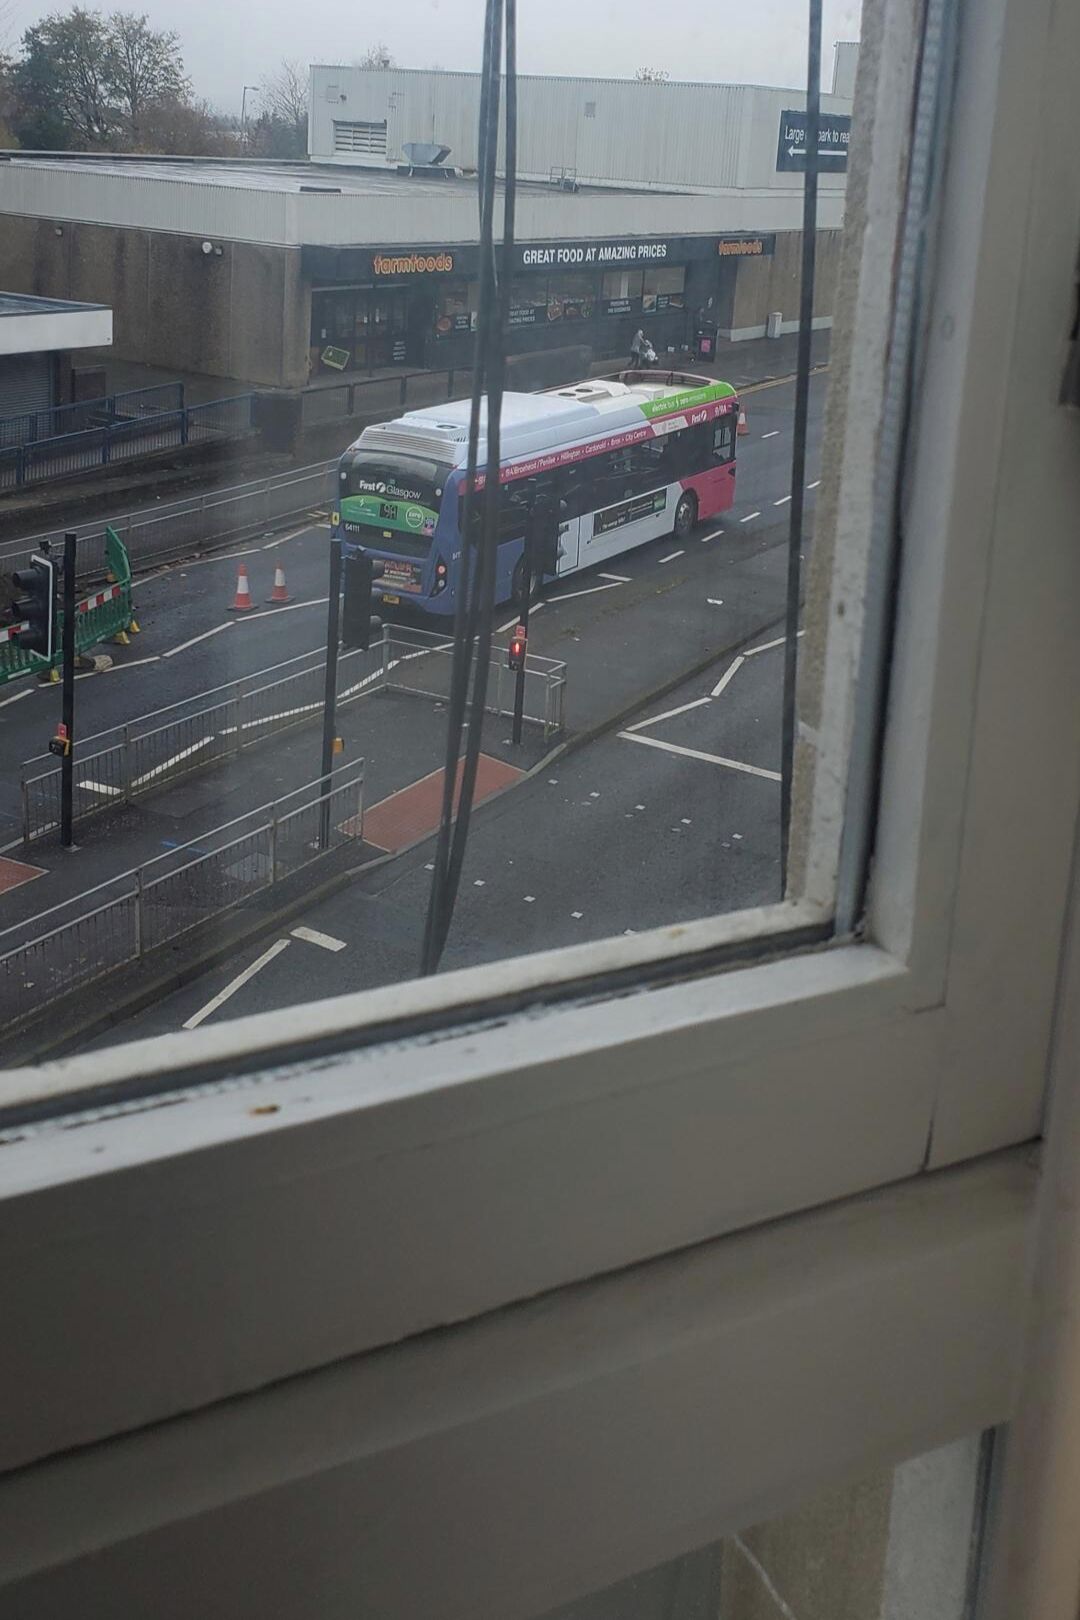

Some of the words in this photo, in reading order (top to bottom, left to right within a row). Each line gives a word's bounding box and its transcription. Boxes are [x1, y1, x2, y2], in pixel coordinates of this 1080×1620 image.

[784, 125, 805, 144] Large
[832, 130, 839, 142] to
[839, 131, 850, 143] rea
[523, 249, 556, 264] GREAT
[557, 248, 584, 263] FOOD
[585, 247, 597, 261] AT
[598, 245, 637, 261] AMAZING
[637, 244, 667, 258] PRICES
[373, 253, 453, 275] farmfoods
[625, 433, 633, 442] City
[359, 480, 376, 491] First
[386, 484, 421, 499] Glasgow
